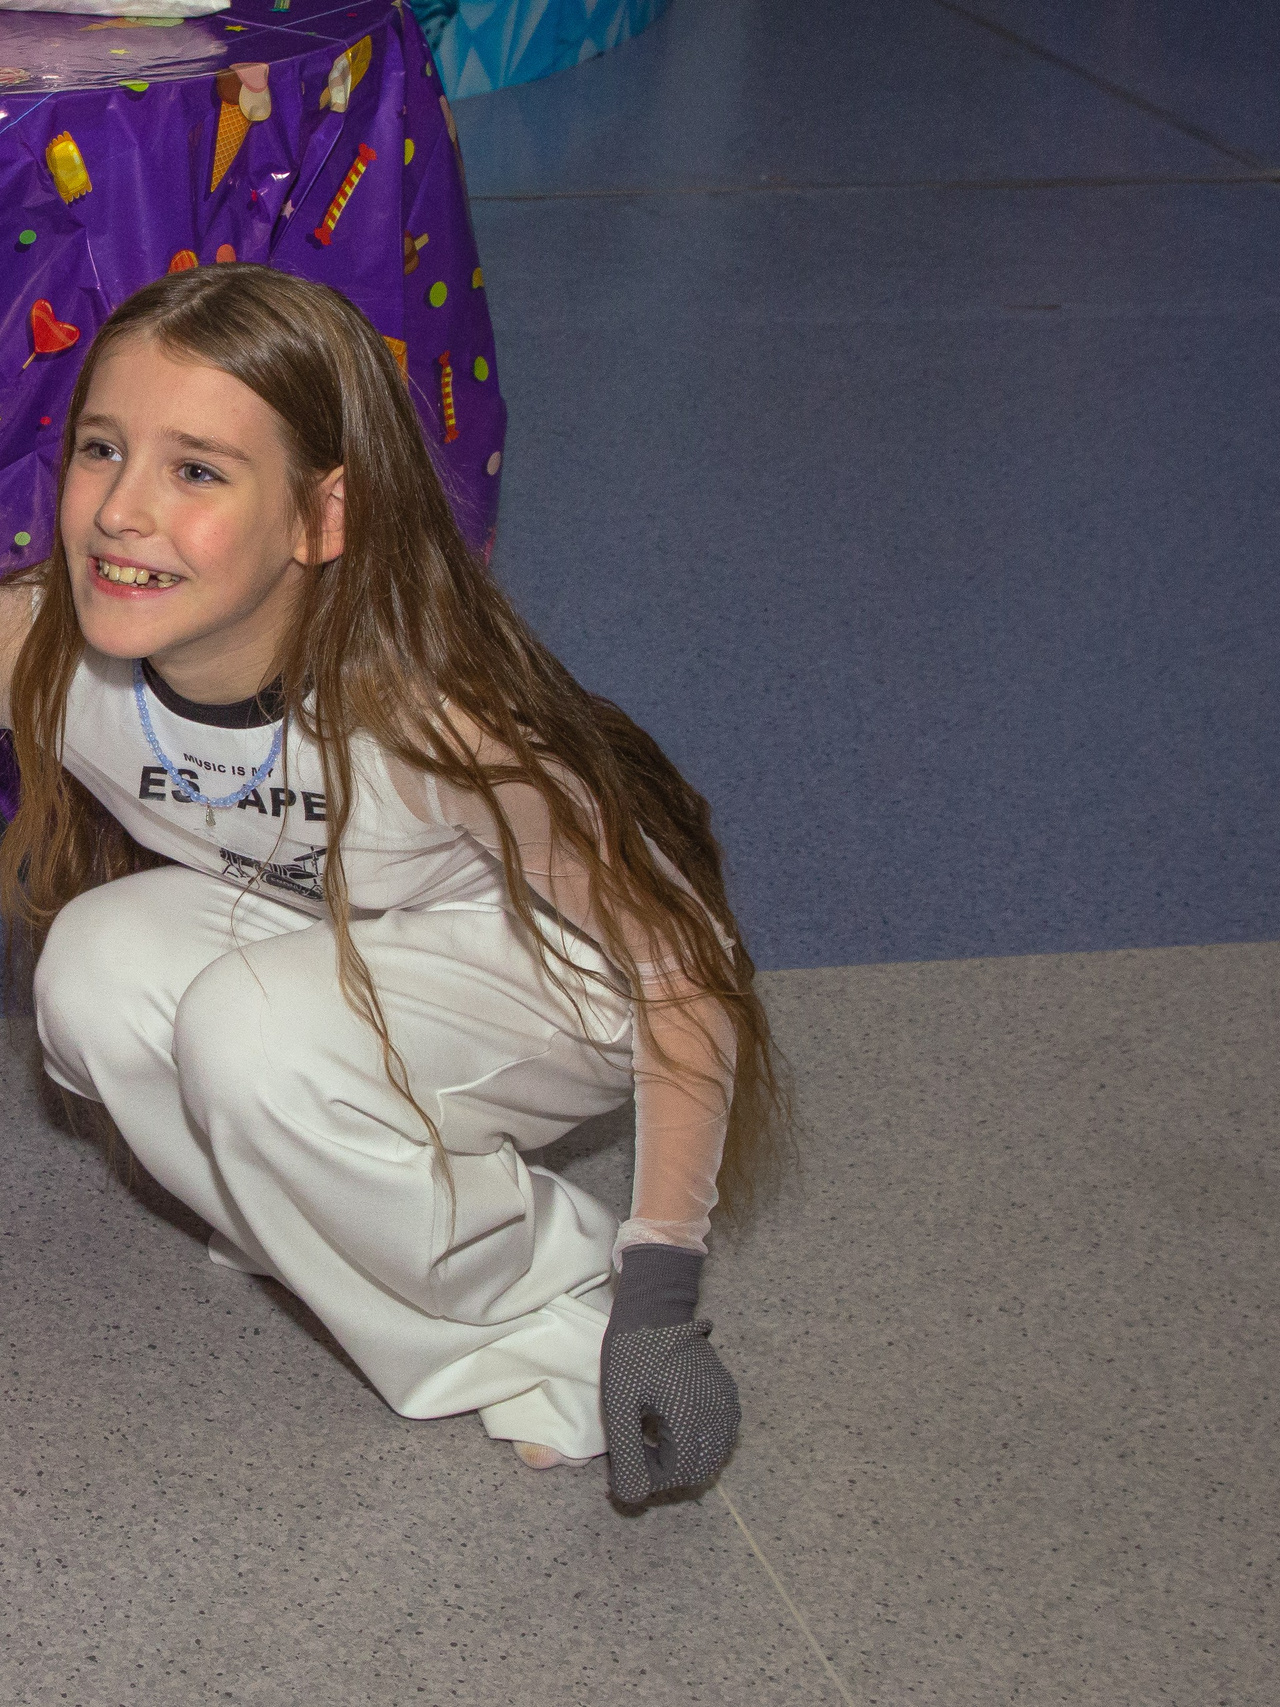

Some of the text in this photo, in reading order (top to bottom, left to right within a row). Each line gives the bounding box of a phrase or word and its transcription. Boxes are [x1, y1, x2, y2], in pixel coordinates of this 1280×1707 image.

[183, 752, 227, 774] MUSIC
[231, 765, 246, 776] IS
[138, 765, 327, 822] ESAPE
